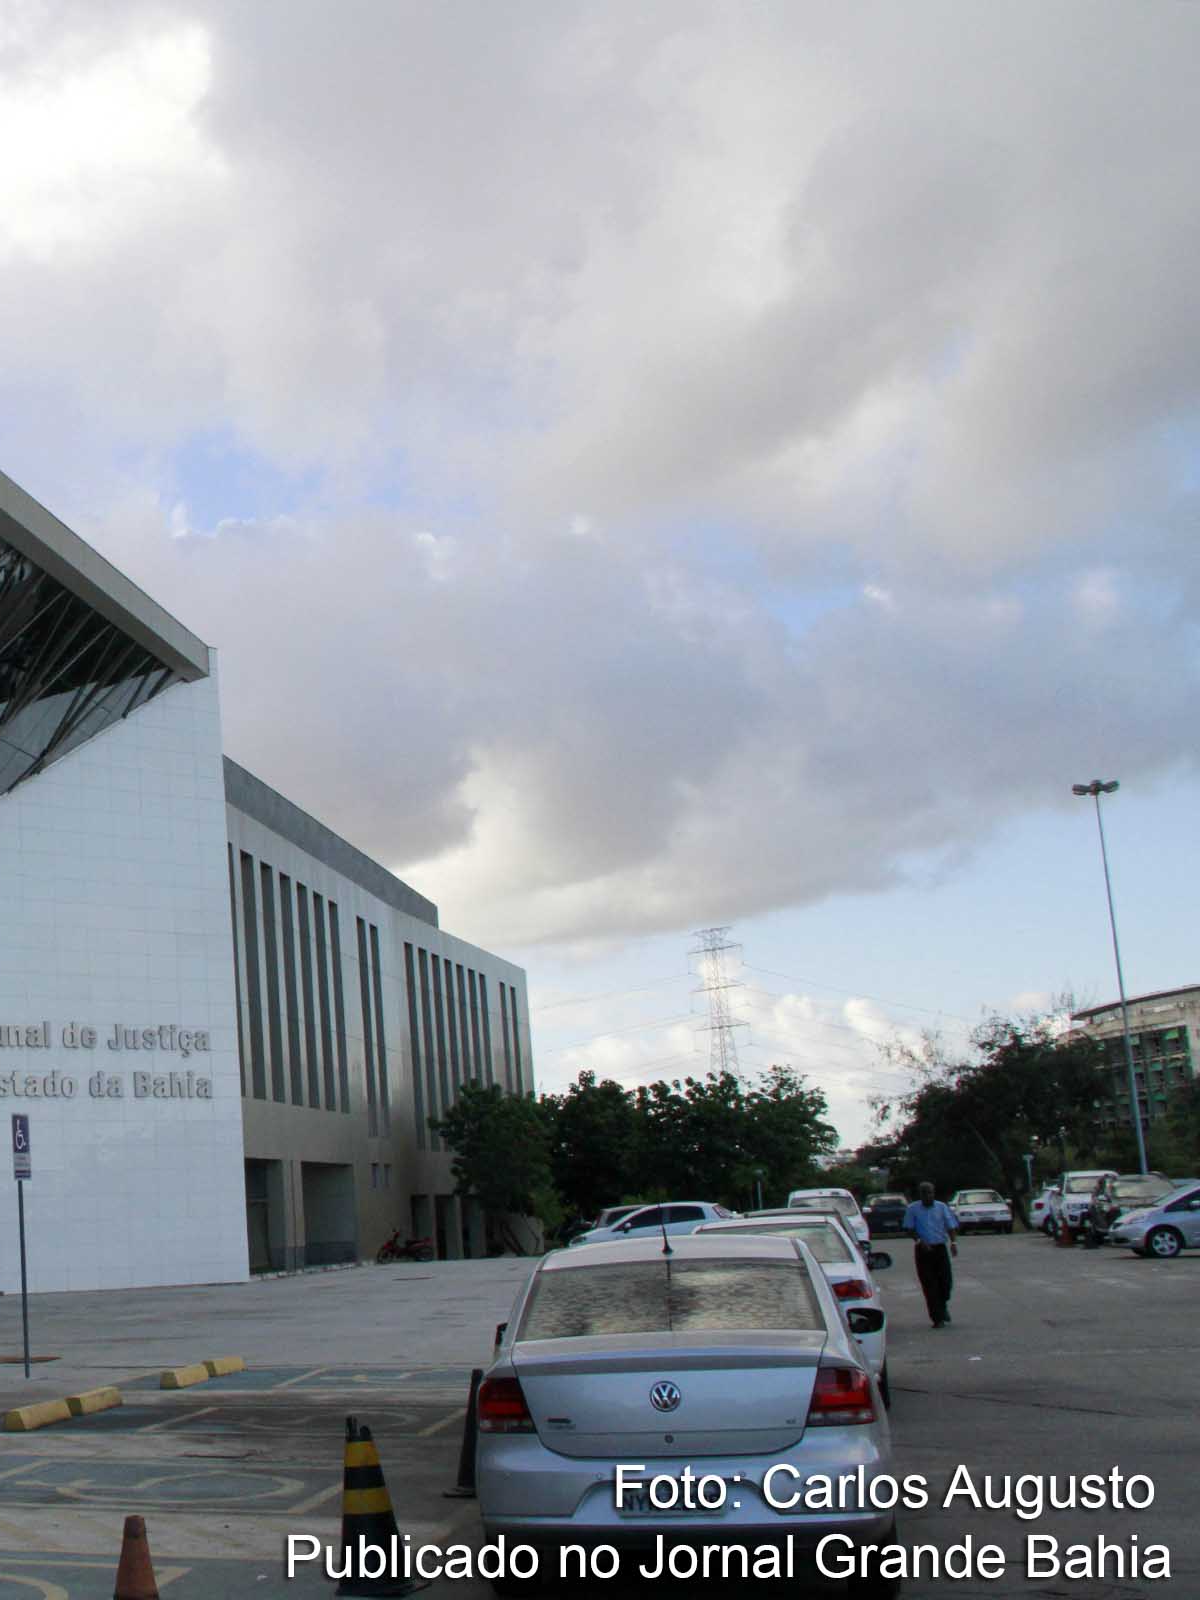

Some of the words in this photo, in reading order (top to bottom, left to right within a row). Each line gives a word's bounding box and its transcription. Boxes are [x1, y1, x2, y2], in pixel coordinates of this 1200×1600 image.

[61, 1020, 98, 1050] de
[106, 1022, 211, 1058] Justiça
[87, 1070, 123, 1098] da
[132, 1070, 213, 1099] Bahia
